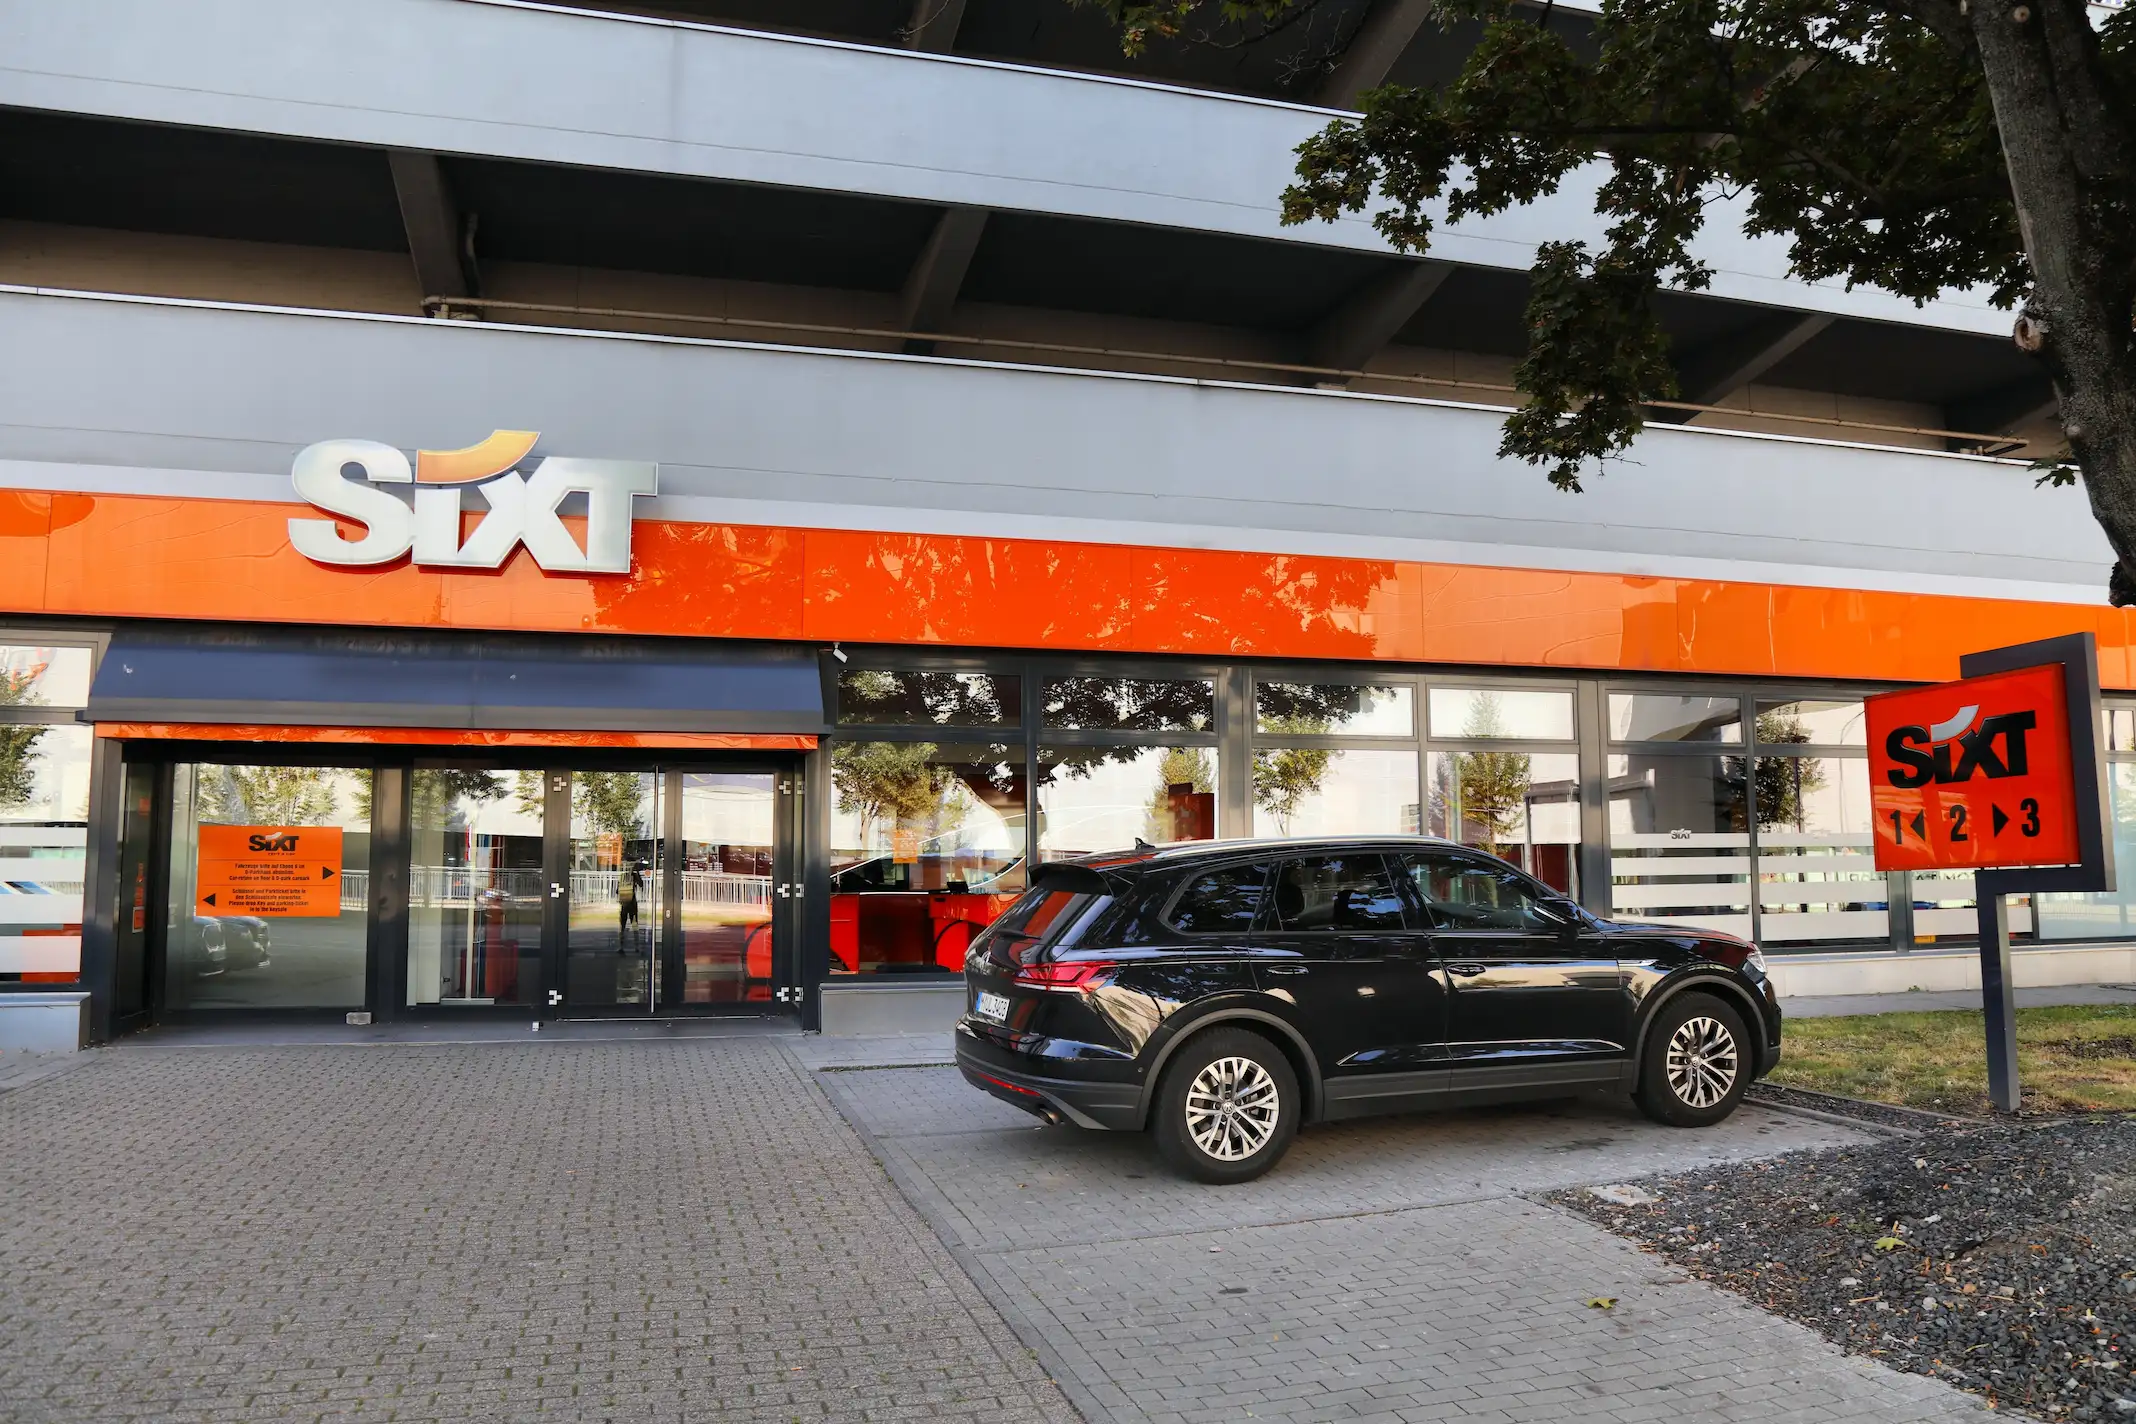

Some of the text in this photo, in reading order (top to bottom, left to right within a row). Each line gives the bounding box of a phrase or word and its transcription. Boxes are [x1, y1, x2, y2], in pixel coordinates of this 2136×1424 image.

[288, 430, 658, 573] SIXT
[1886, 704, 2036, 788] SIXT
[248, 832, 299, 852] SIXT
[1889, 798, 2040, 845] 1 2 3
